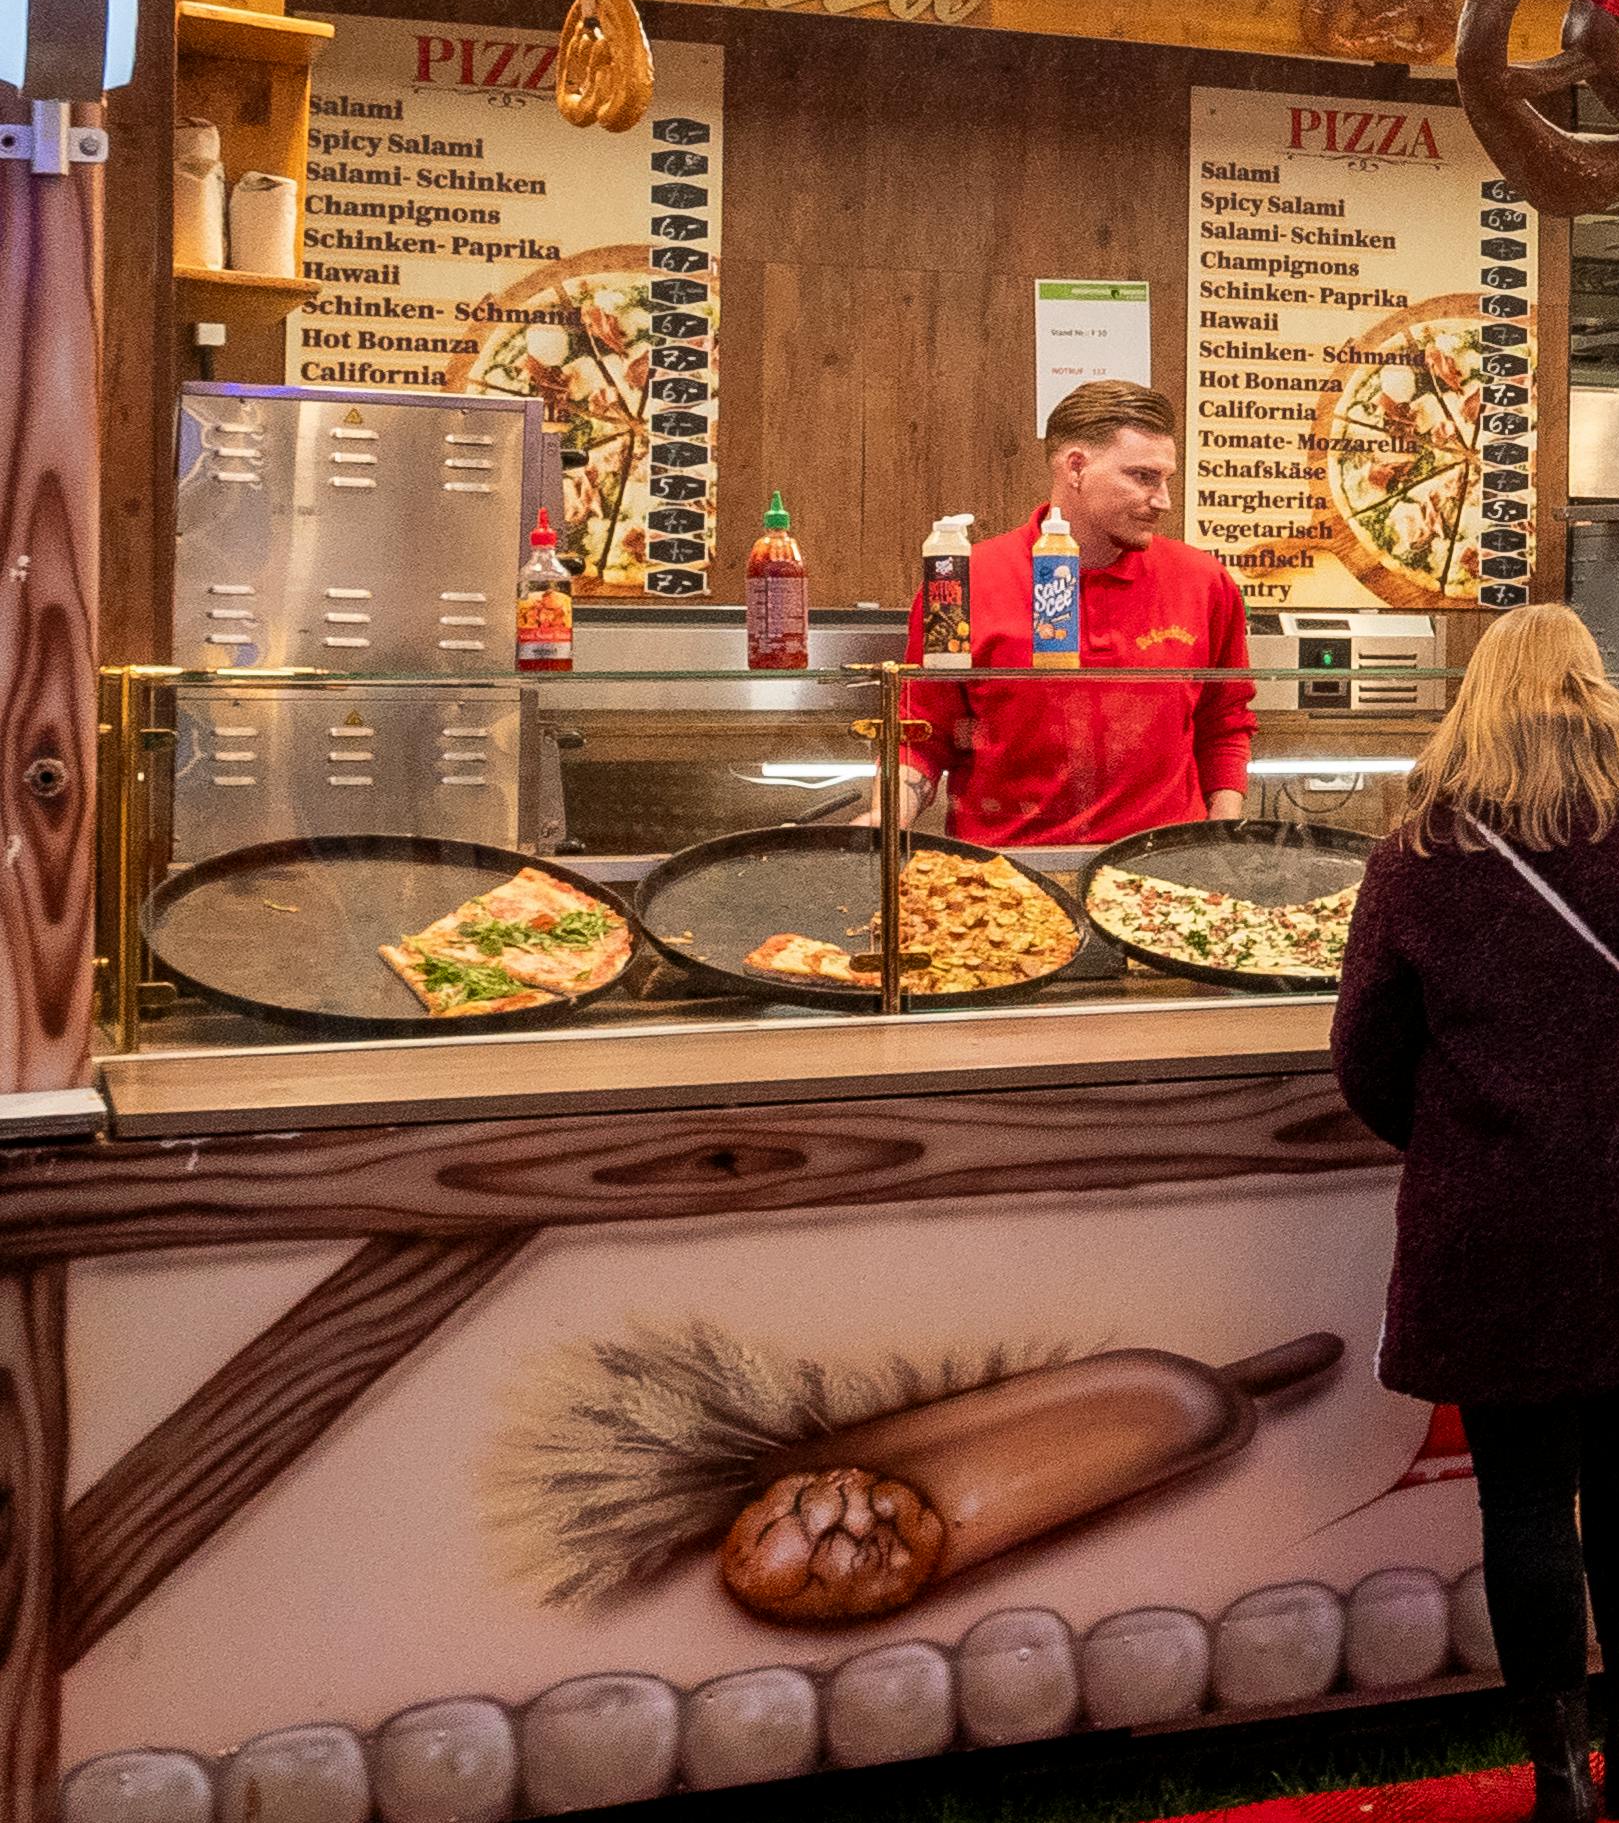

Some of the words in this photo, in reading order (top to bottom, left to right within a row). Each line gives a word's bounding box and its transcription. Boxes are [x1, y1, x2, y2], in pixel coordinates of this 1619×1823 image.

[413, 34, 562, 92] PIZZ
[308, 95, 404, 121] Salami
[307, 129, 382, 157] Spicy
[387, 133, 485, 160] Salami
[1287, 106, 1442, 160] PIZZA
[416, 168, 547, 195] Schinken
[1200, 161, 1280, 184] Salami
[304, 194, 501, 227] Champignons
[1200, 191, 1264, 218] Spicy
[1268, 195, 1345, 217] Salami
[303, 228, 446, 254] Schinken-
[451, 237, 562, 263] Paprika
[1199, 221, 1286, 244] Salami-
[1290, 226, 1397, 250] Schinken
[301, 261, 401, 287] Hawaii
[1200, 250, 1360, 278] Champignons
[1199, 279, 1315, 304] Schinken-
[1319, 287, 1409, 312] Paprika
[300, 294, 444, 321] Schinken-
[454, 301, 583, 328] Schmand
[1199, 310, 1280, 332] Hawaii
[301, 328, 351, 352] Hot
[357, 331, 480, 355] Bonanza
[1198, 340, 1314, 364] Schinken-
[1323, 345, 1427, 367] Schmand
[301, 360, 447, 387] California
[1198, 370, 1241, 392] Hot
[1244, 371, 1344, 393] Bonanza
[1198, 399, 1318, 422] California
[1198, 429, 1293, 452] Tomate-
[1297, 432, 1418, 455] Mozzarella
[1197, 459, 1326, 481] Schafskäse
[1197, 489, 1328, 515] Margherita
[1197, 519, 1333, 544] Vegetarisch
[1240, 581, 1292, 603] ntry
